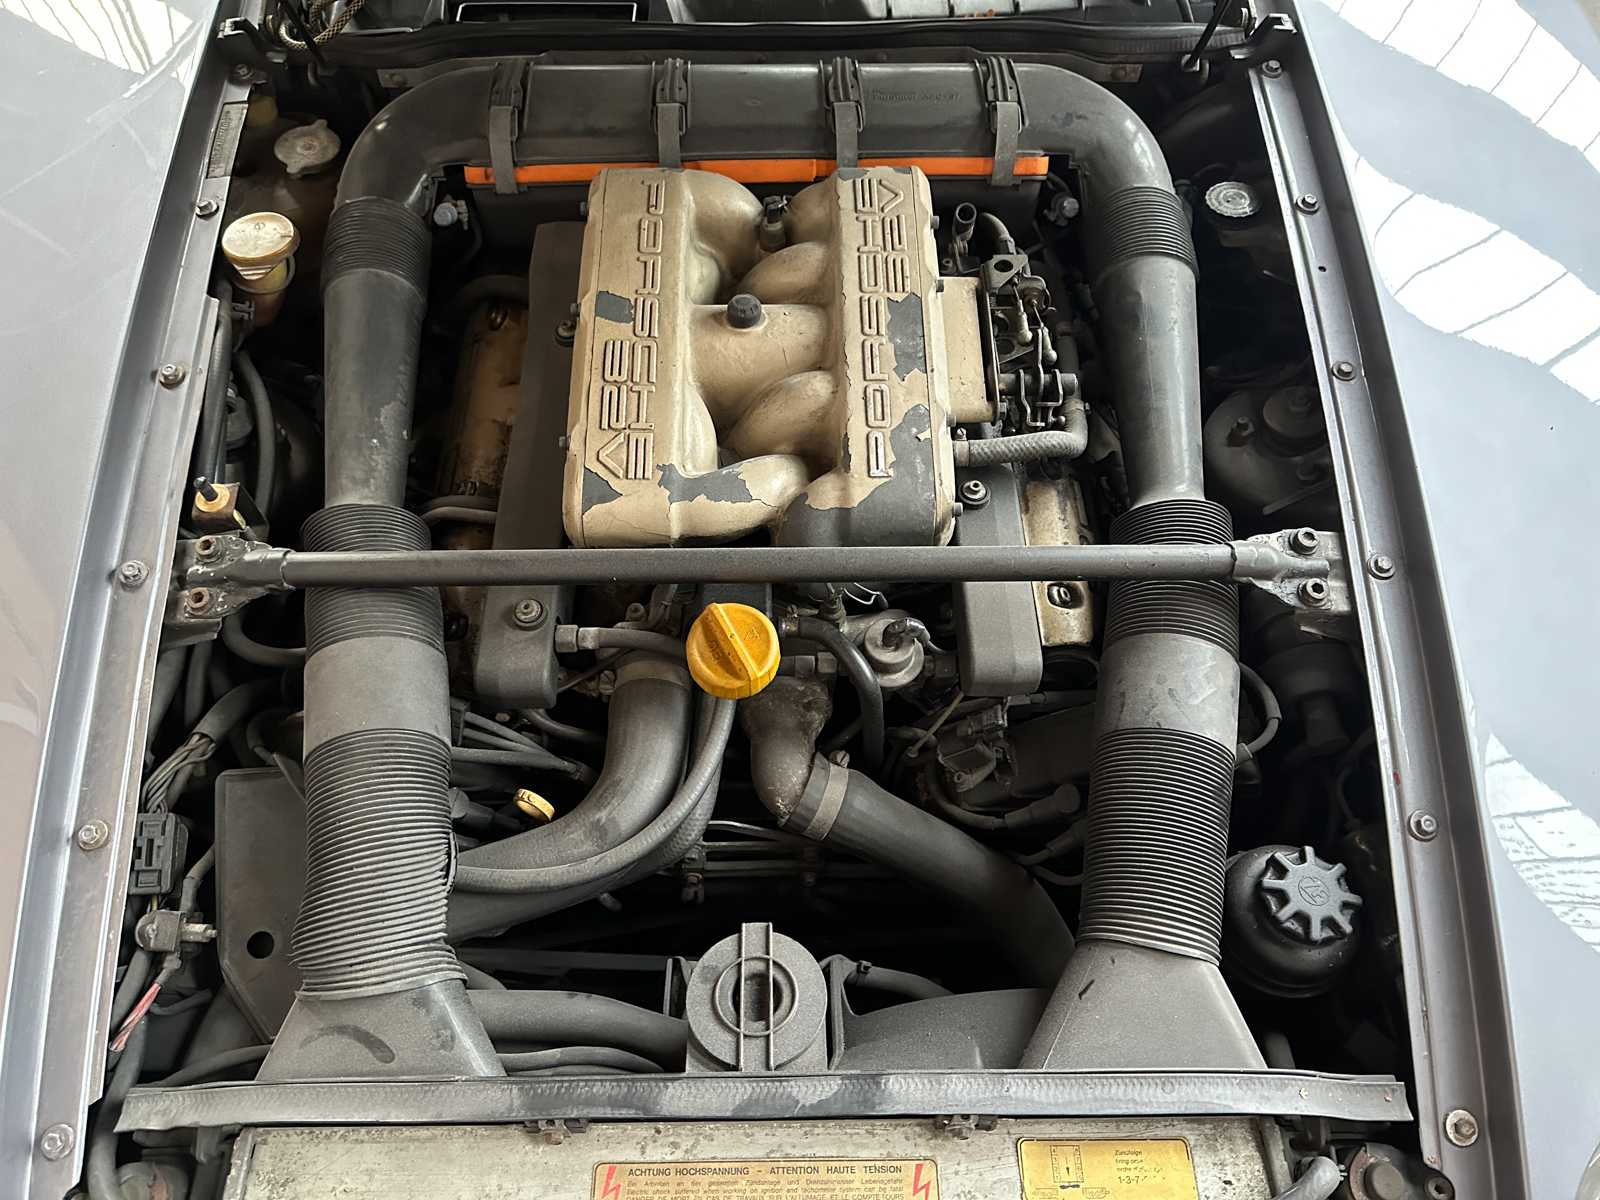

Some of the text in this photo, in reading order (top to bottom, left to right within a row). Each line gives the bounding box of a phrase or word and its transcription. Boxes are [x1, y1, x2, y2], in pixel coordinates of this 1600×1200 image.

[880, 178, 911, 293] 32V
[627, 177, 665, 480] PORSCHE
[855, 178, 892, 478] PORSCHE
[597, 339, 630, 479] 32V
[628, 1168, 671, 1177] ACHTUNG
[675, 1167, 750, 1177] HOCHSPANNUNG
[769, 1165, 819, 1175] ATTENTION
[826, 1165, 856, 1174] HAUTE
[863, 1164, 902, 1174] TENSION
[761, 1187, 782, 1195] ignition
[861, 1178, 903, 1186] Lebensgefahr
